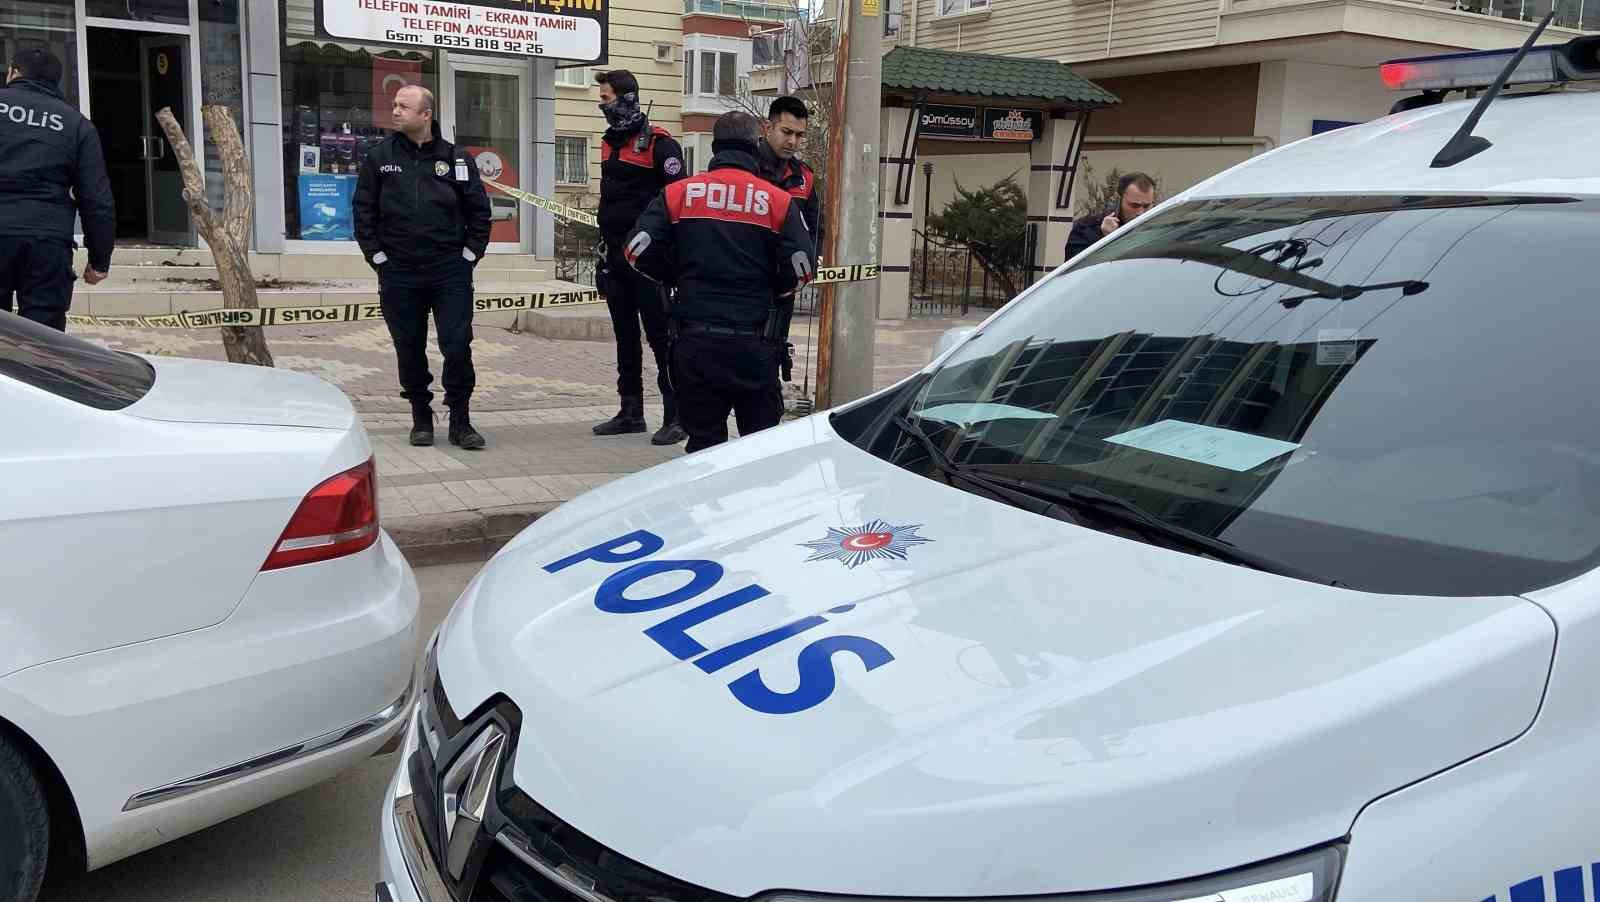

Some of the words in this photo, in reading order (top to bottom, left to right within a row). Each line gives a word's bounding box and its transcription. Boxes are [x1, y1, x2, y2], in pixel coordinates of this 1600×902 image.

[358, 0, 418, 14] TELEFON
[424, 4, 471, 19] TAMİRİ
[486, 11, 529, 26] EKRAN
[533, 17, 577, 31] TAMİRİ
[402, 17, 460, 34] TELEFON
[466, 24, 538, 41] AKSESUARI
[386, 30, 423, 43] Gsm:
[434, 34, 469, 47] 0535
[475, 38, 499, 50] 818
[504, 41, 521, 52] 92
[526, 43, 544, 54] 26
